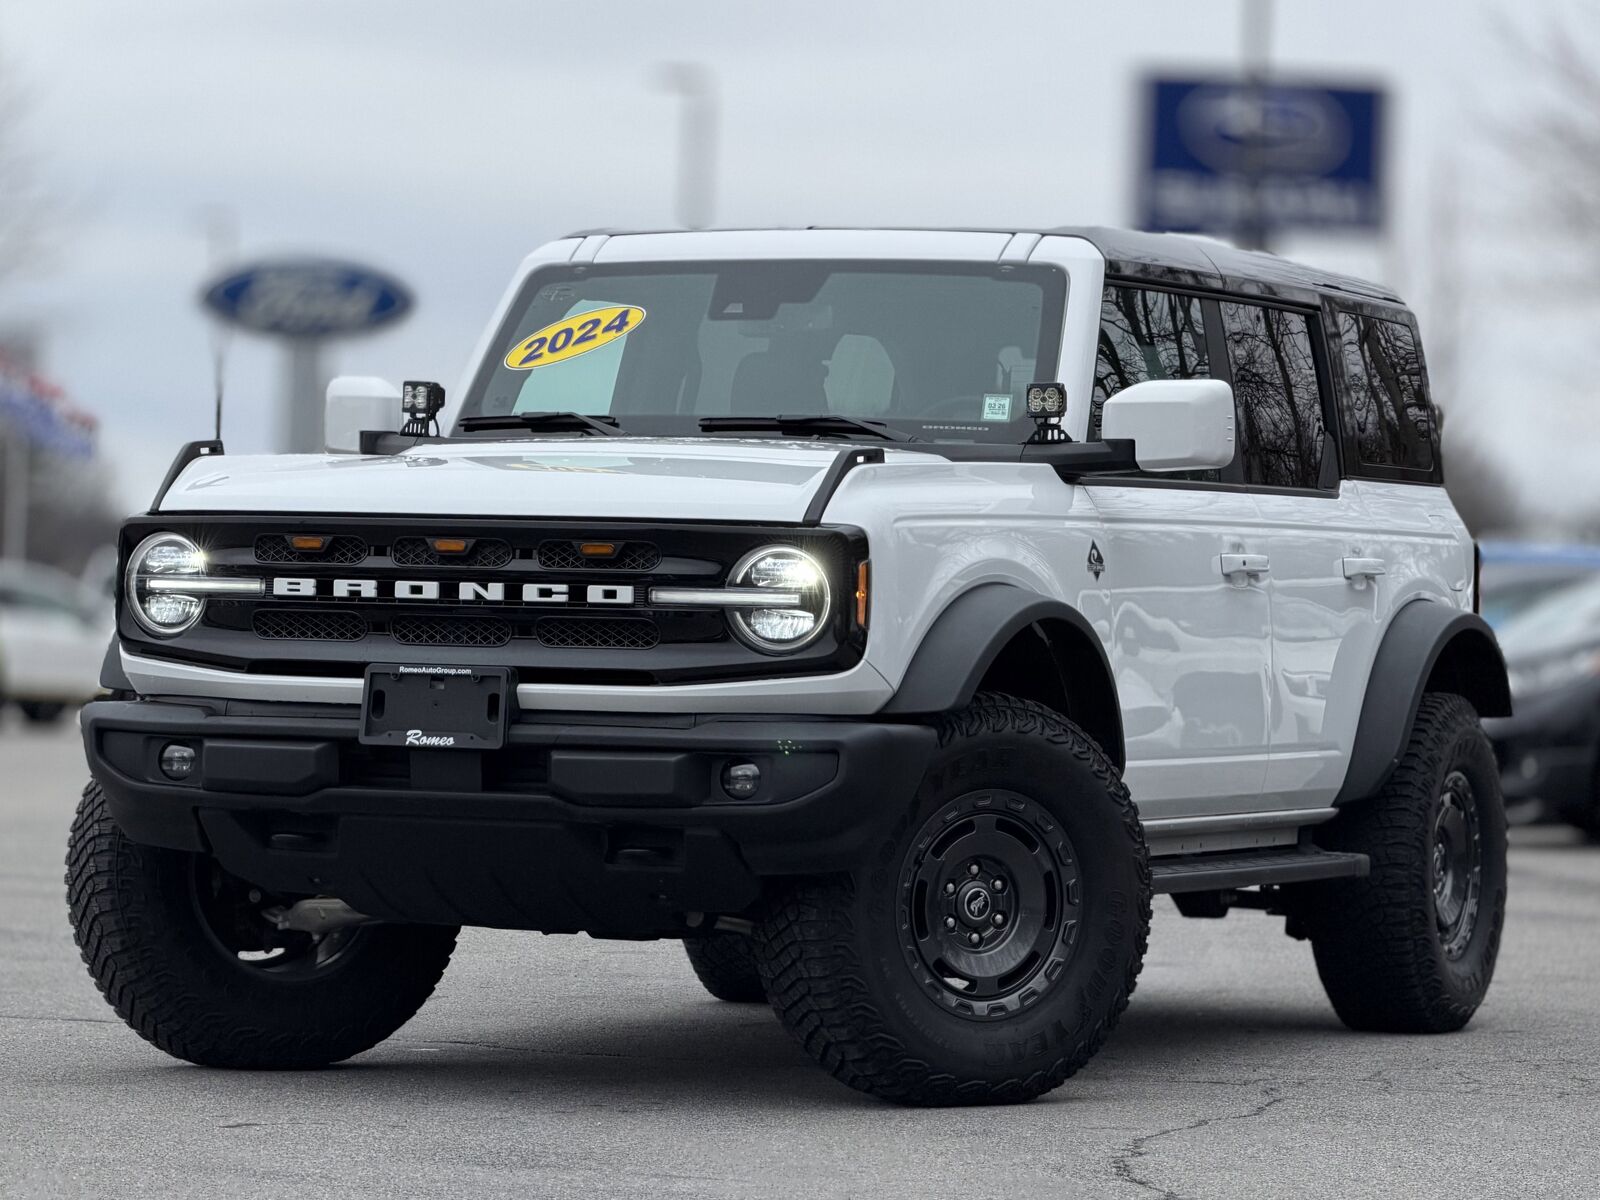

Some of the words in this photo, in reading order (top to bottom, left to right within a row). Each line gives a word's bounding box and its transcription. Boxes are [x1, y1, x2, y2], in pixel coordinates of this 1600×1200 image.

[517, 308, 631, 367] 2024
[272, 577, 634, 604] BRONCO
[399, 665, 472, 676] RomeoAutoGroup.com
[405, 729, 455, 746] Romeo
